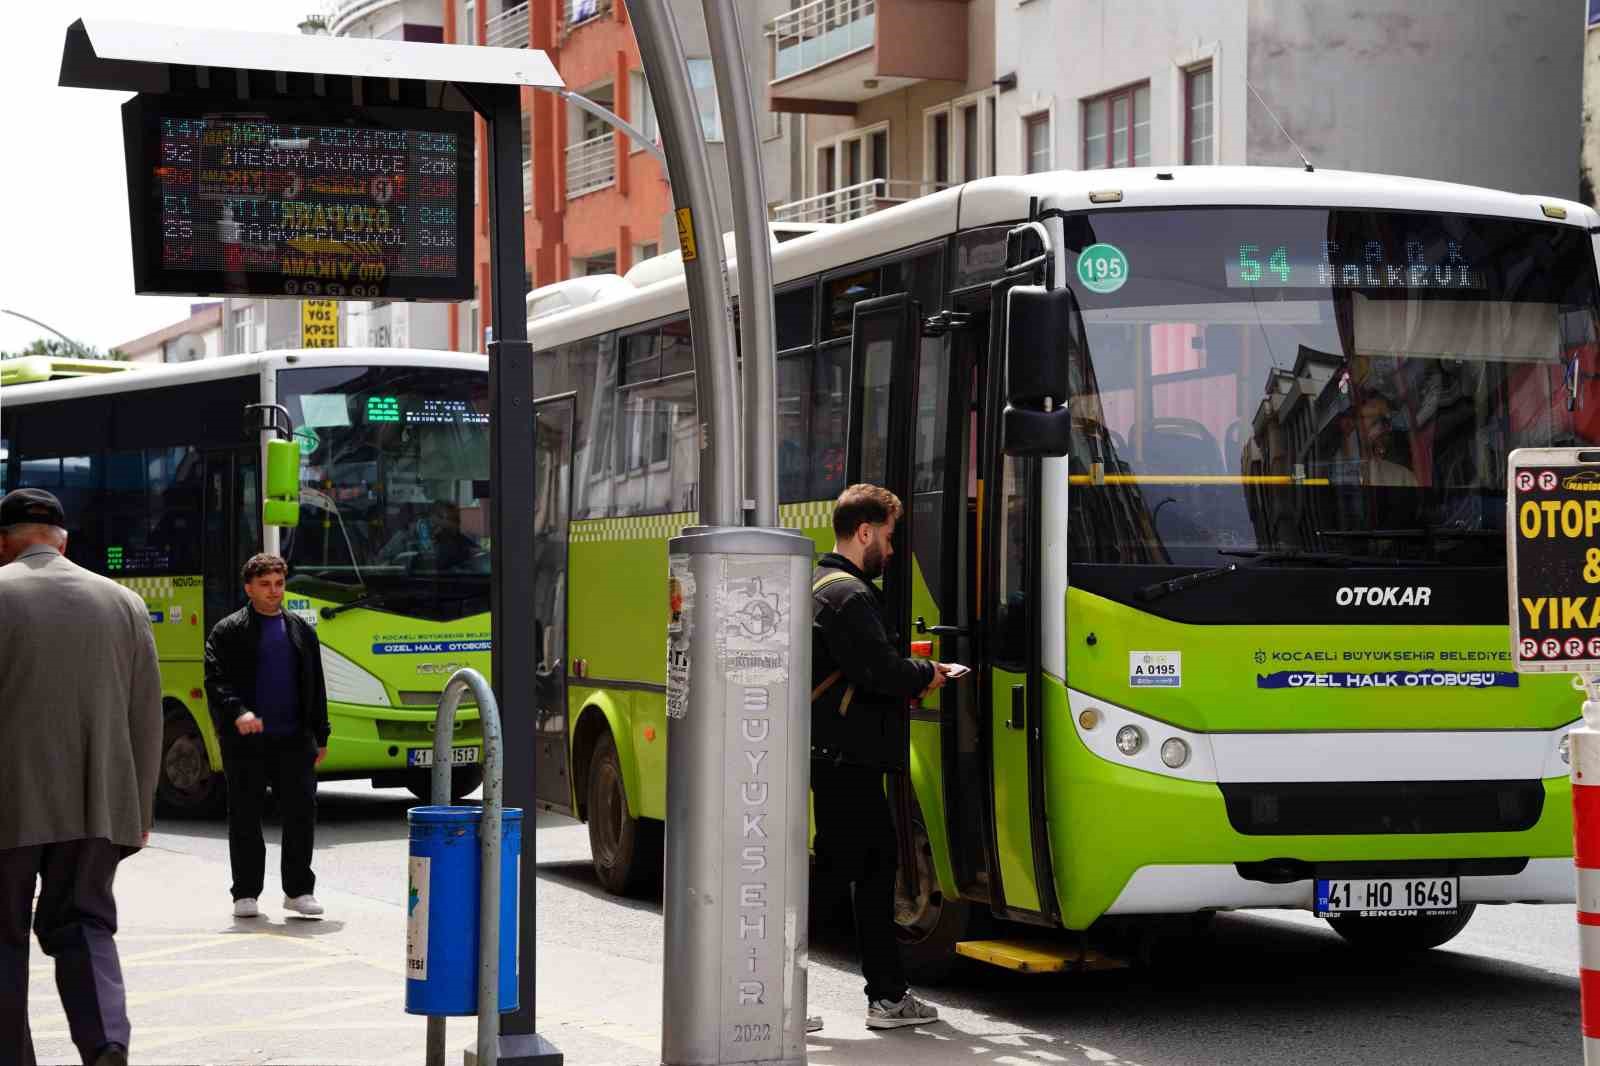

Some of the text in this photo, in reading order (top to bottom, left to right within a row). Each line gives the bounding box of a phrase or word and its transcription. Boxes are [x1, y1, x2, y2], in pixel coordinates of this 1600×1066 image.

[1082, 257, 1123, 280] 195
[1238, 244, 1293, 284] 54
[1335, 586, 1432, 607] OTOKAR
[1135, 664, 1175, 675] A 0195
[1288, 673, 1496, 687] ÖZEL HALK OTOBÜSÜ
[1329, 880, 1352, 908] 41
[1404, 880, 1454, 907] 1649
